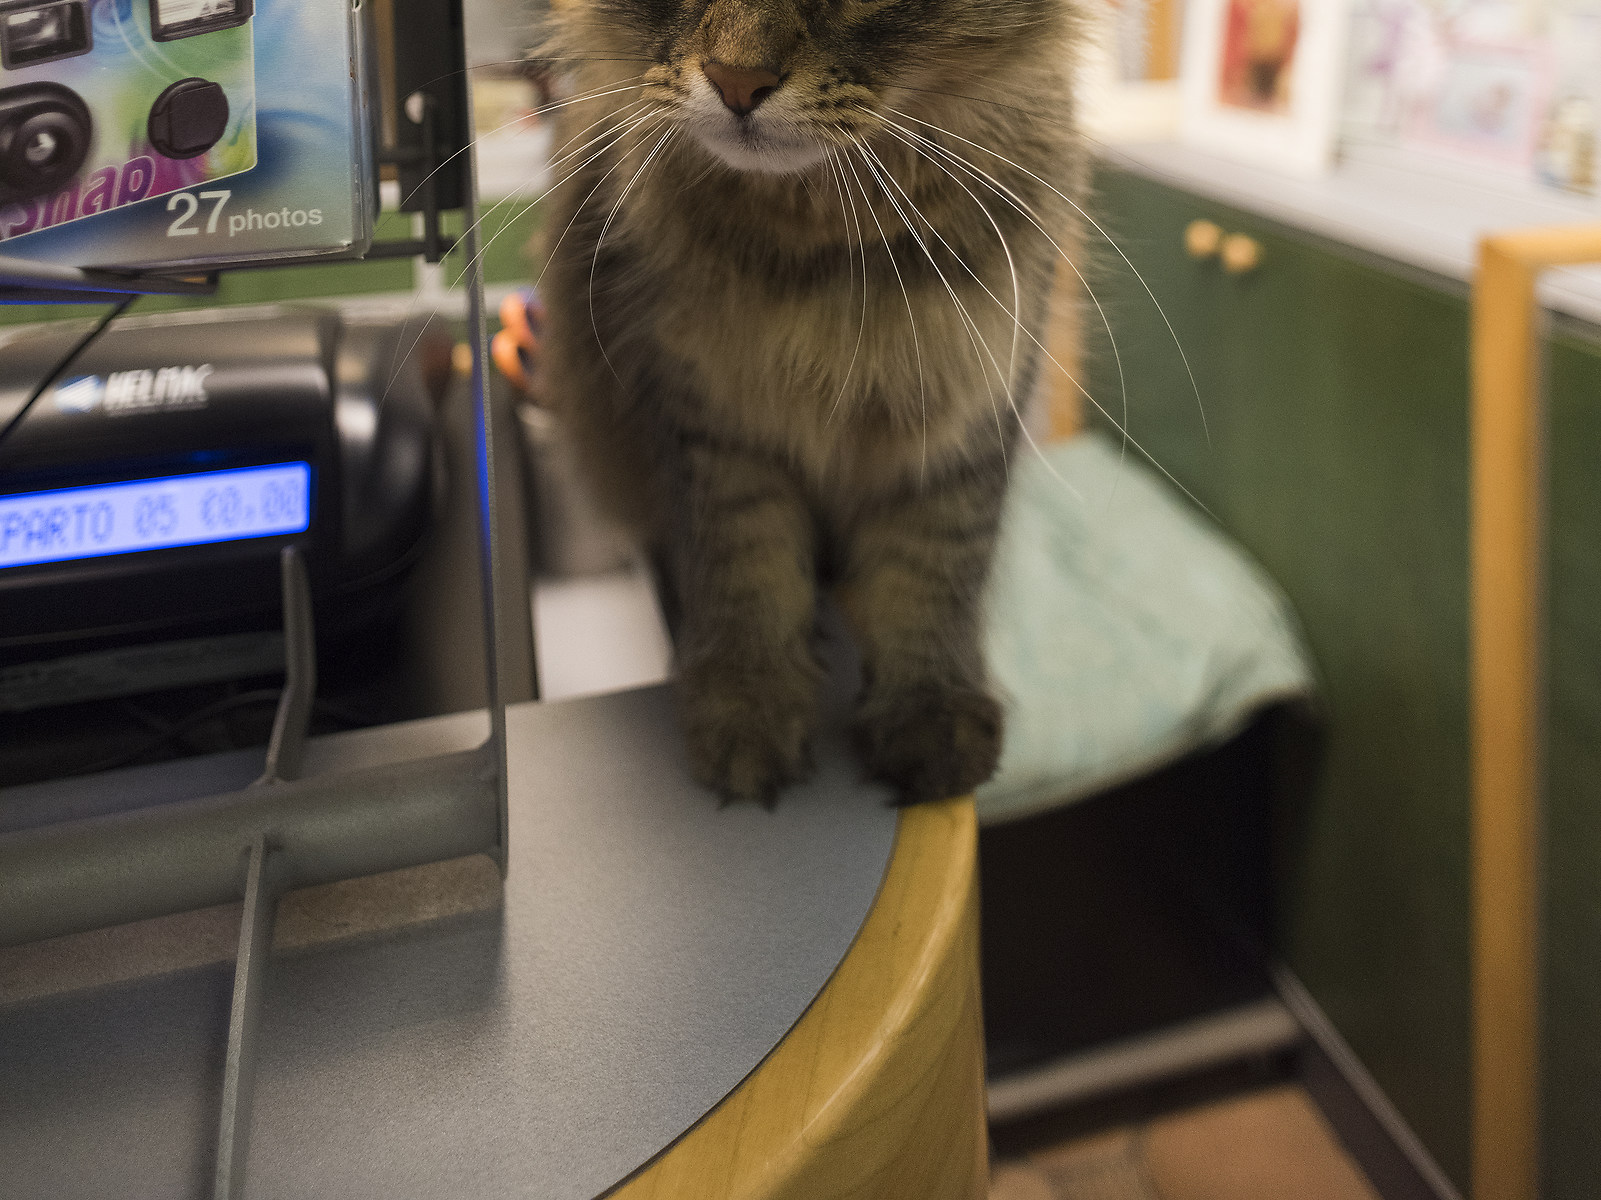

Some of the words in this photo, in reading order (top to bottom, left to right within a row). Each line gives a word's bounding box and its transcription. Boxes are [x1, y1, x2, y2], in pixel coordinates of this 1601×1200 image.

[166, 190, 231, 237] 27
[229, 206, 323, 237] photos
[0, 500, 115, 553] PARTO
